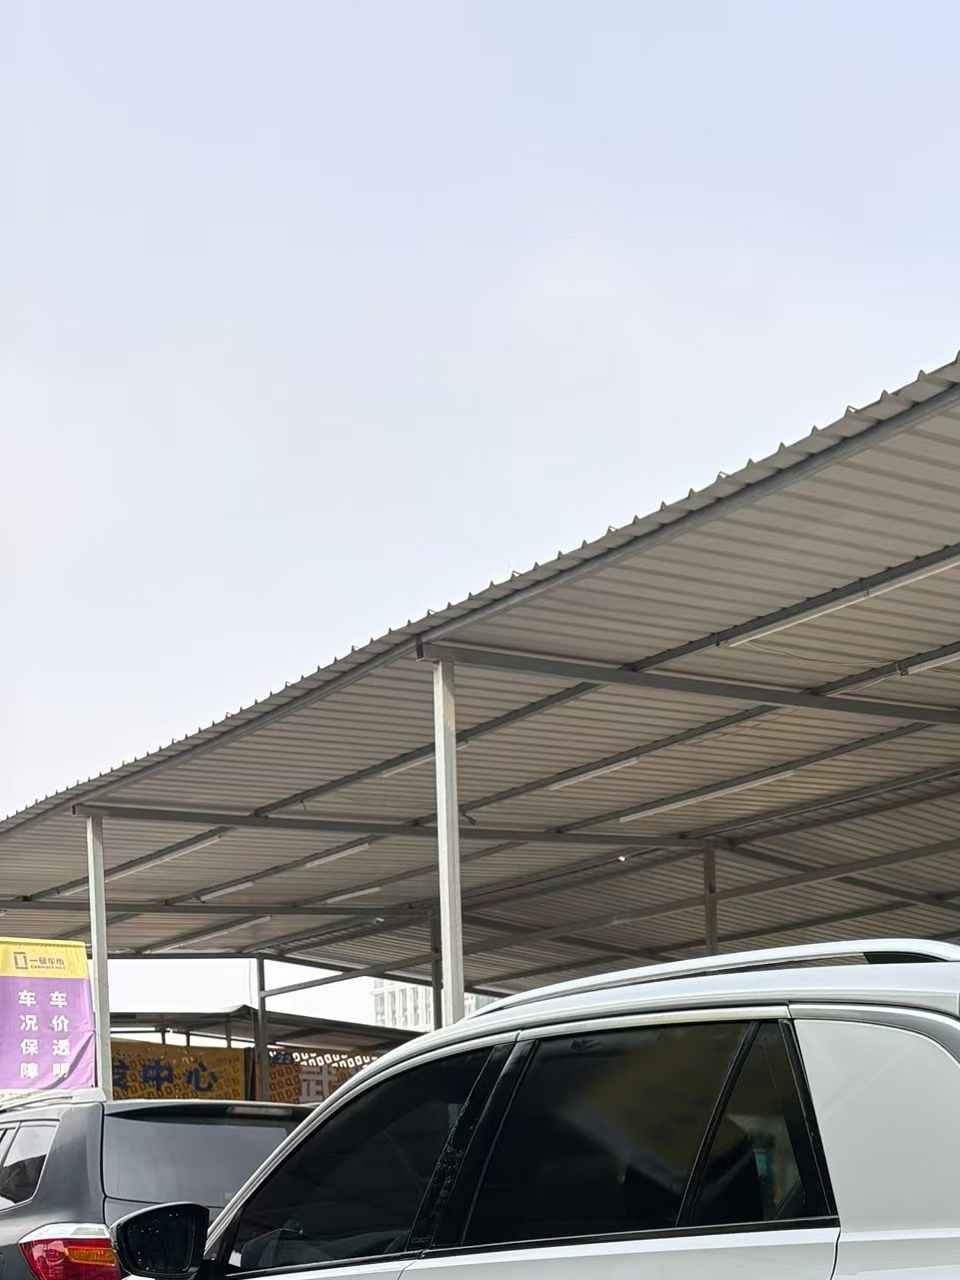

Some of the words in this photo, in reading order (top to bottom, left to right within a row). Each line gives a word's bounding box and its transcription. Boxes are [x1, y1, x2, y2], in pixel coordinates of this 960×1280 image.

[18, 990, 39, 1079] 车况保障
[50, 991, 71, 1079] 车价透明
